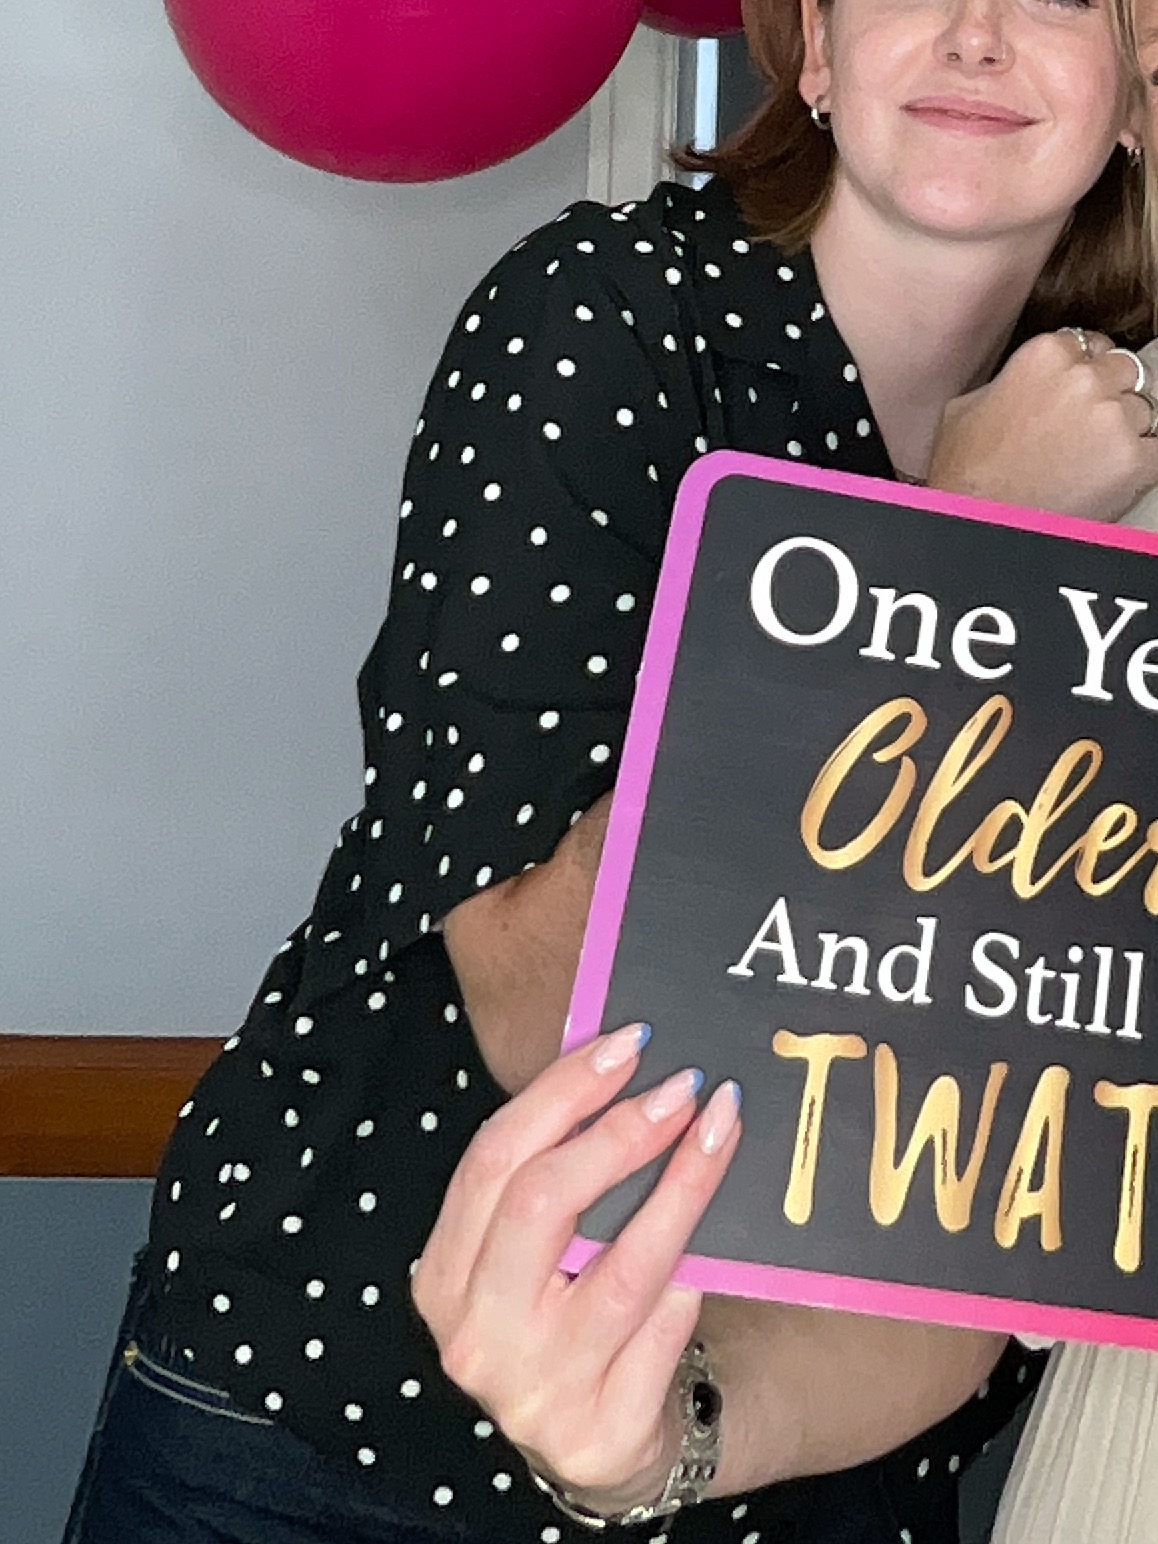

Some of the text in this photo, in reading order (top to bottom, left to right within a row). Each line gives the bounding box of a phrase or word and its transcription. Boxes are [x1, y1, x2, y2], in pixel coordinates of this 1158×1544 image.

[749, 536, 1017, 680] One
[727, 896, 939, 1006] And
[964, 932, 1144, 1040] Still
